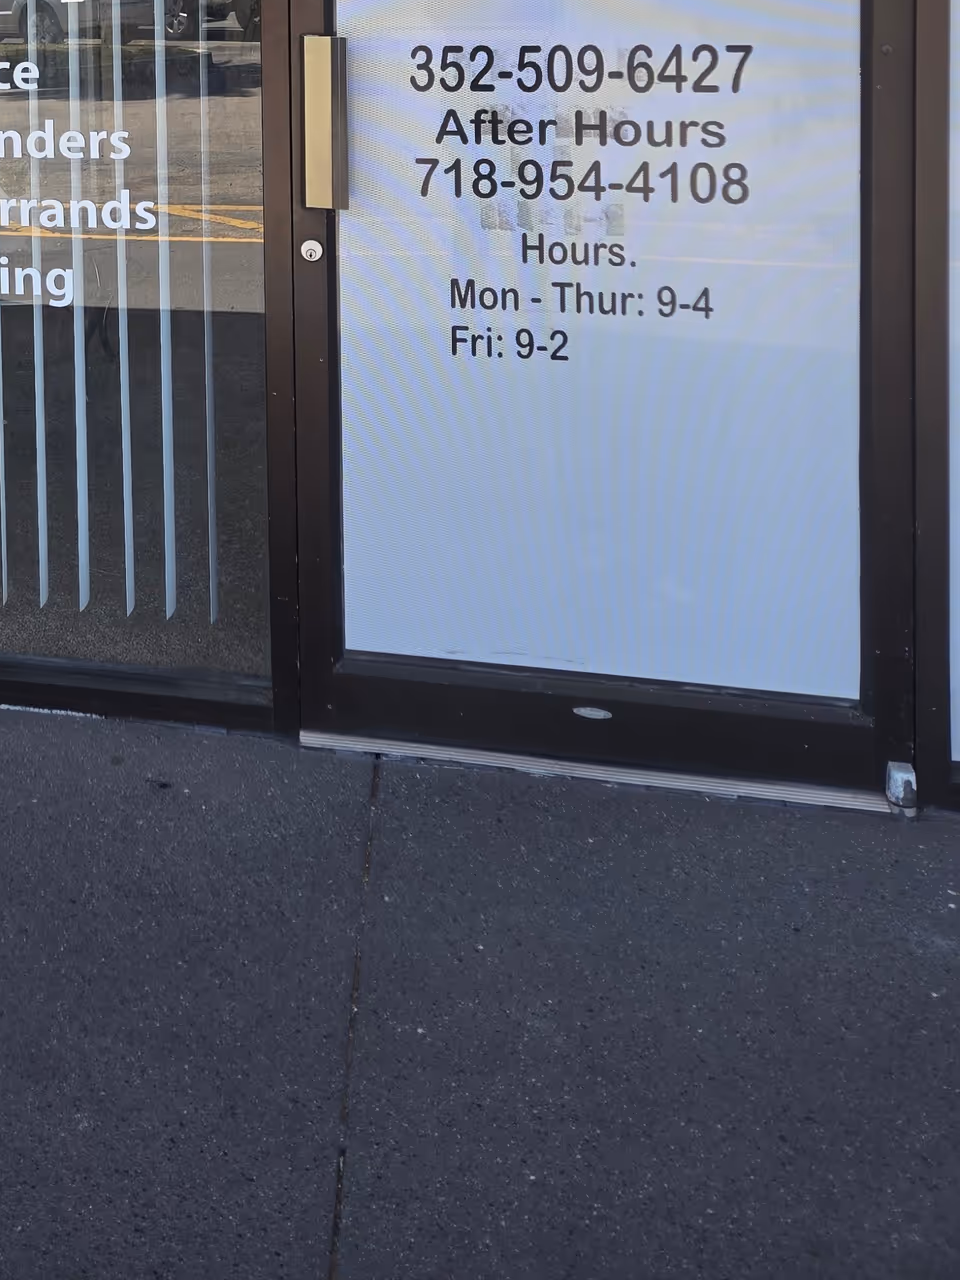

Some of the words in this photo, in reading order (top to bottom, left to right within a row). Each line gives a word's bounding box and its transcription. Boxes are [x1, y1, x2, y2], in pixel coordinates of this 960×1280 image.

[409, 44, 754, 94] 352-509-6427
[435, 109, 558, 147] After
[575, 111, 726, 148] Hours
[414, 158, 749, 205] 718-954-4108
[520, 232, 637, 268] Hours.
[449, 278, 519, 312] Mon
[551, 281, 644, 315] Thur:
[657, 286, 714, 319] 9-4
[450, 325, 503, 358] Fri:
[515, 328, 569, 361] 9-2
